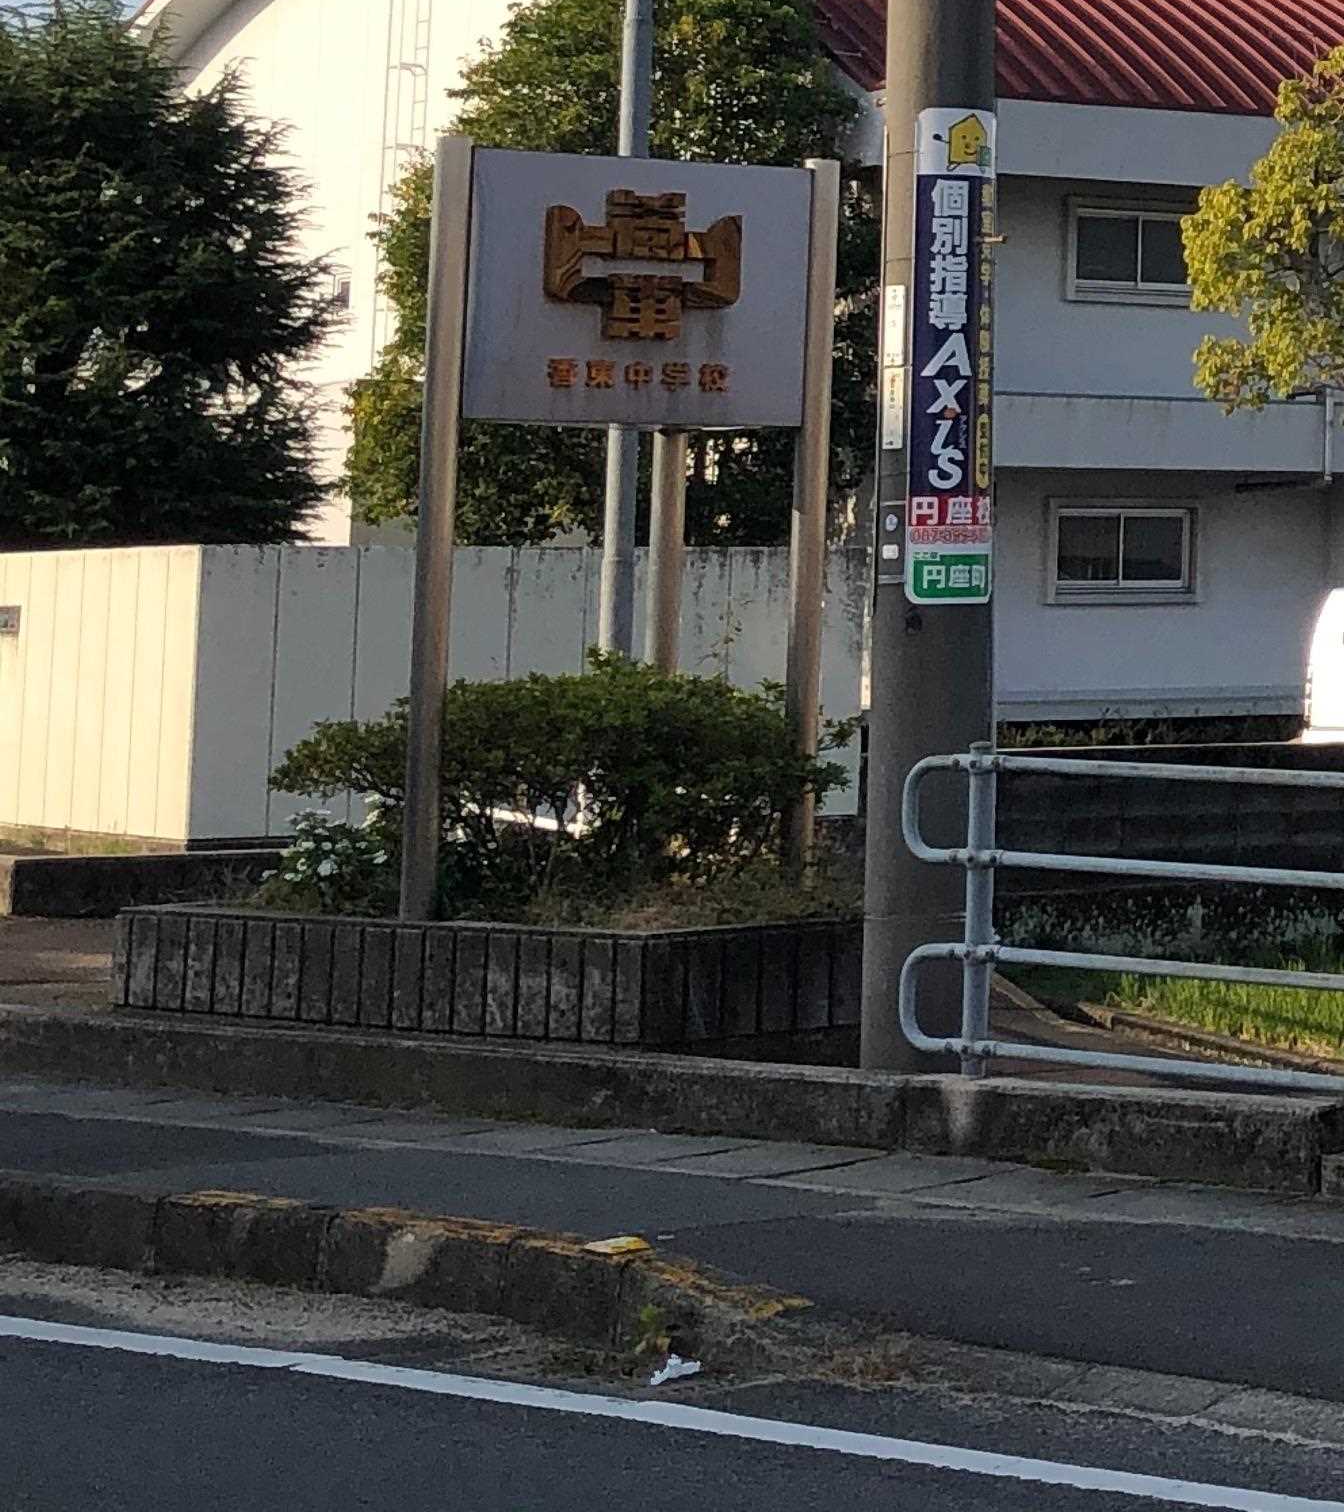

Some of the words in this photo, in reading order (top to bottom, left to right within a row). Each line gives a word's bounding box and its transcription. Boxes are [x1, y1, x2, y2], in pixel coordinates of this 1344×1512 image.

[547, 356, 730, 392] 香東中学校
